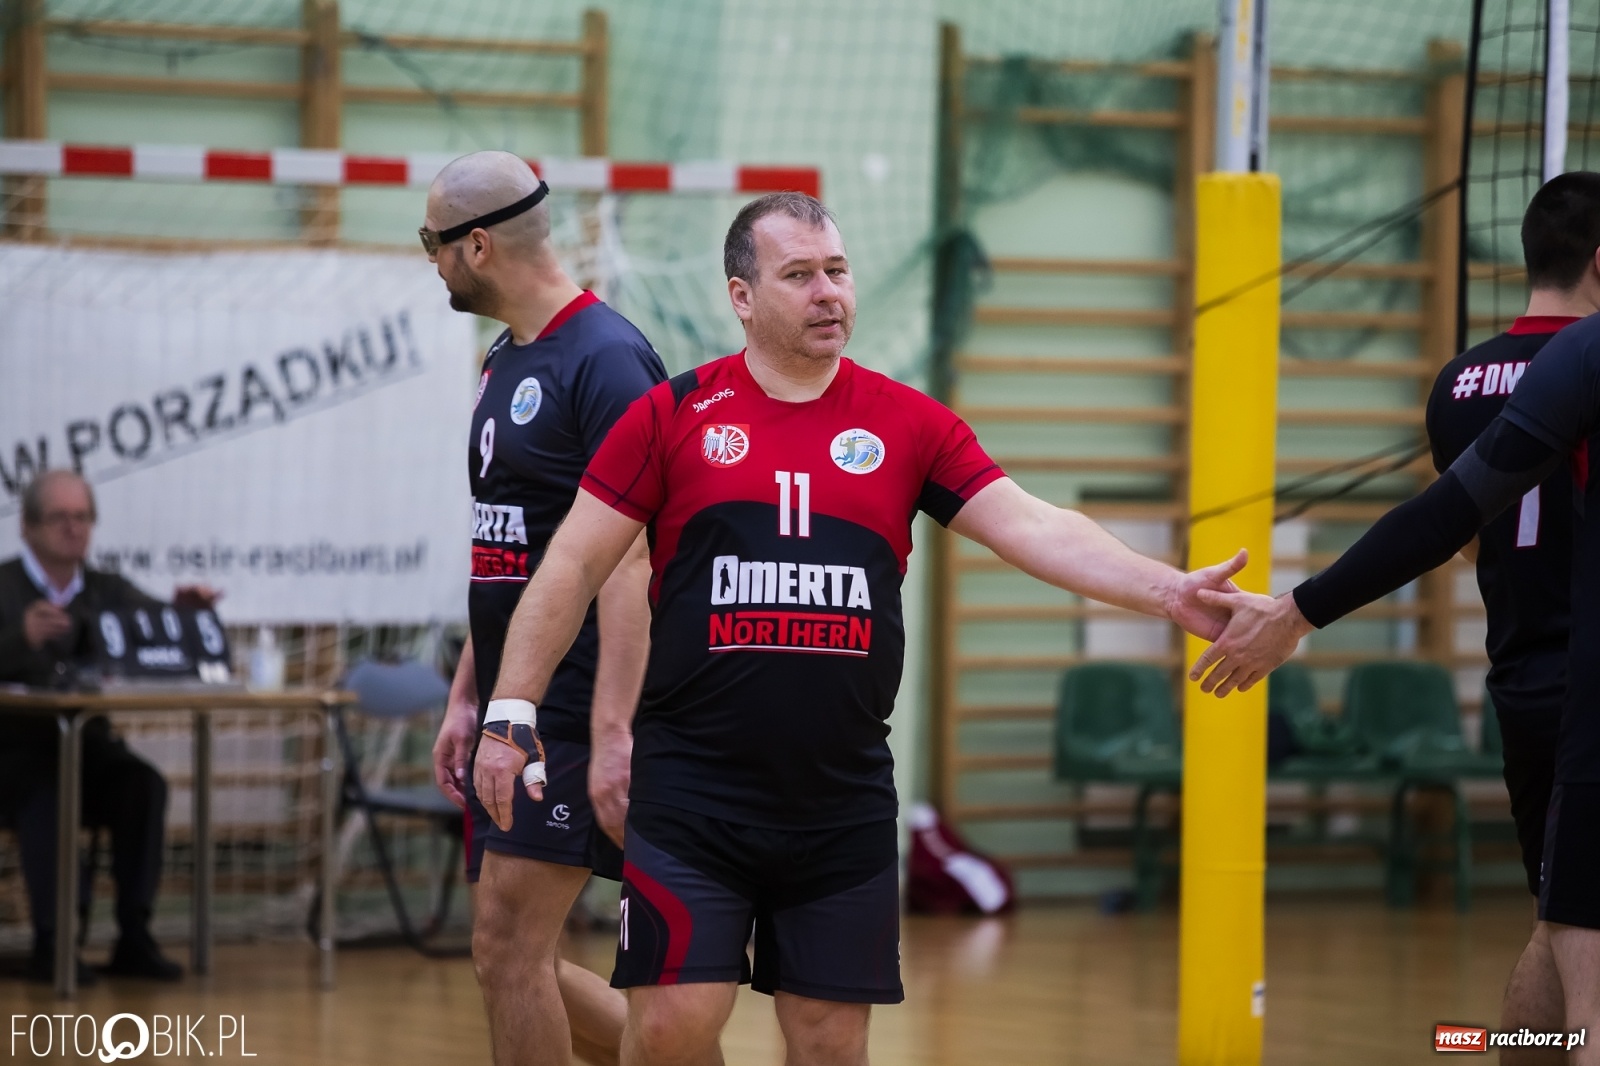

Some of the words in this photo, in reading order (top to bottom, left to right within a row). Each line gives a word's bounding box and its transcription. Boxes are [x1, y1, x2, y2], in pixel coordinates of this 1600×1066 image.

[479, 417, 496, 478] 9
[775, 470, 810, 538] 11
[710, 555, 872, 611] OMERTA
